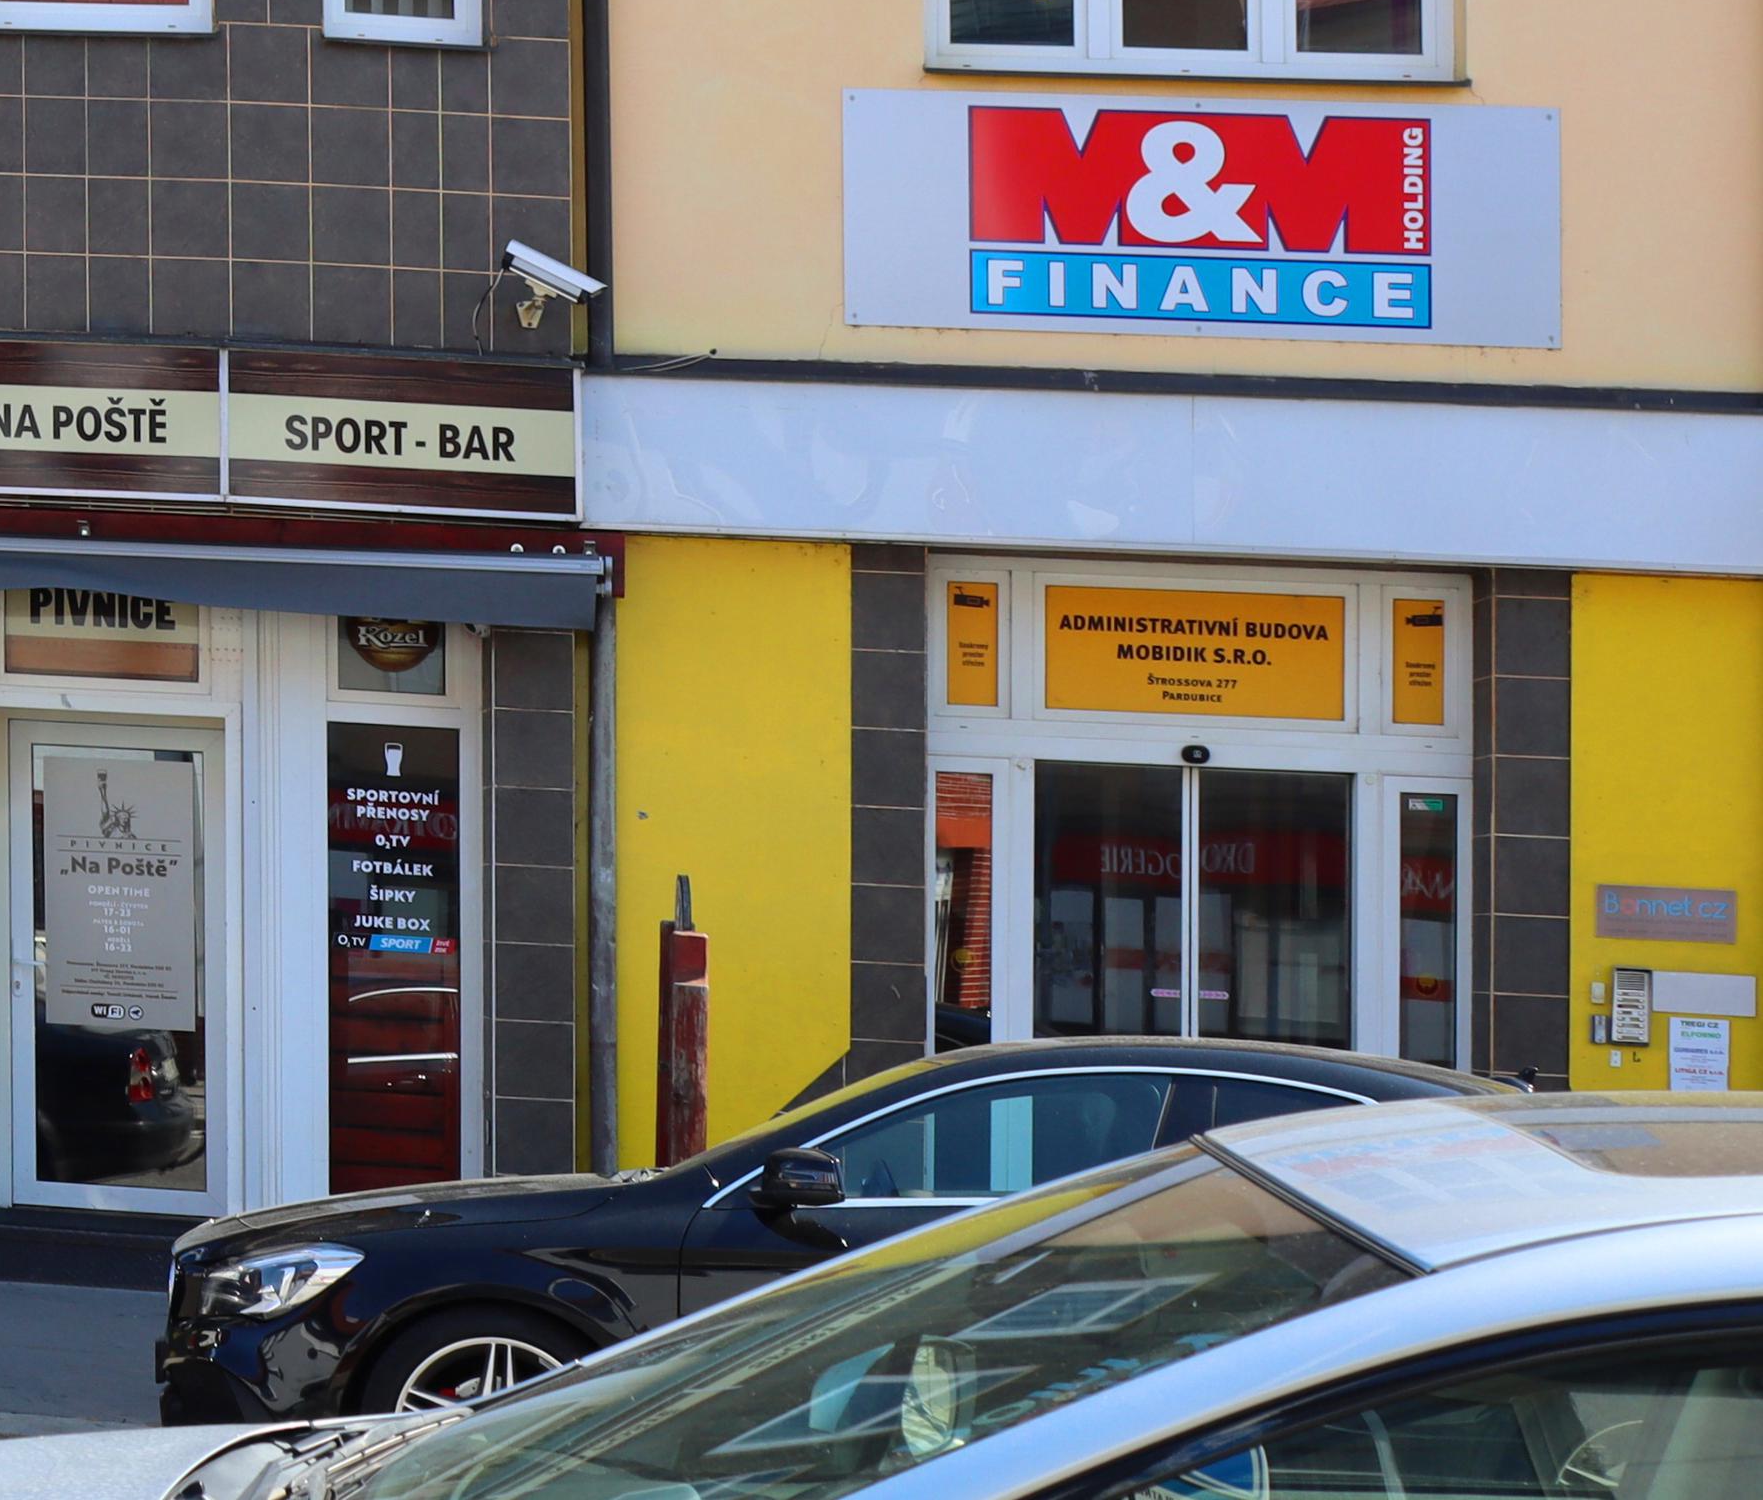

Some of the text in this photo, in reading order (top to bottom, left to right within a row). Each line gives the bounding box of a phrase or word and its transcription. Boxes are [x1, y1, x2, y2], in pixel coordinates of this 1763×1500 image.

[968, 106, 1432, 256] M&M
[1402, 126, 1425, 250] HOLDING
[986, 258, 1416, 320] FINANCE
[52, 397, 167, 443] POŠTĚ
[285, 414, 408, 456] SPORT
[438, 423, 516, 462] BAR
[29, 588, 176, 630] PIVNICE
[357, 626, 428, 648] Kozel
[1060, 615, 1329, 641] ADMINISTRATIVNÍ BUDOVA
[1117, 644, 1272, 666] MOBIDIK S.R.O.
[1216, 679, 1237, 689] 277
[347, 788, 440, 805] SPORTOVNÍ
[357, 803, 430, 821] PŘENOSY
[70, 840, 167, 852] PIVNICE
[352, 859, 433, 876] FOTBÁLEK
[88, 885, 150, 897] OPEN TIME
[370, 885, 416, 903] ŠIPKY
[354, 915, 430, 931] JUKE BOX
[380, 938, 422, 949] SPORT
